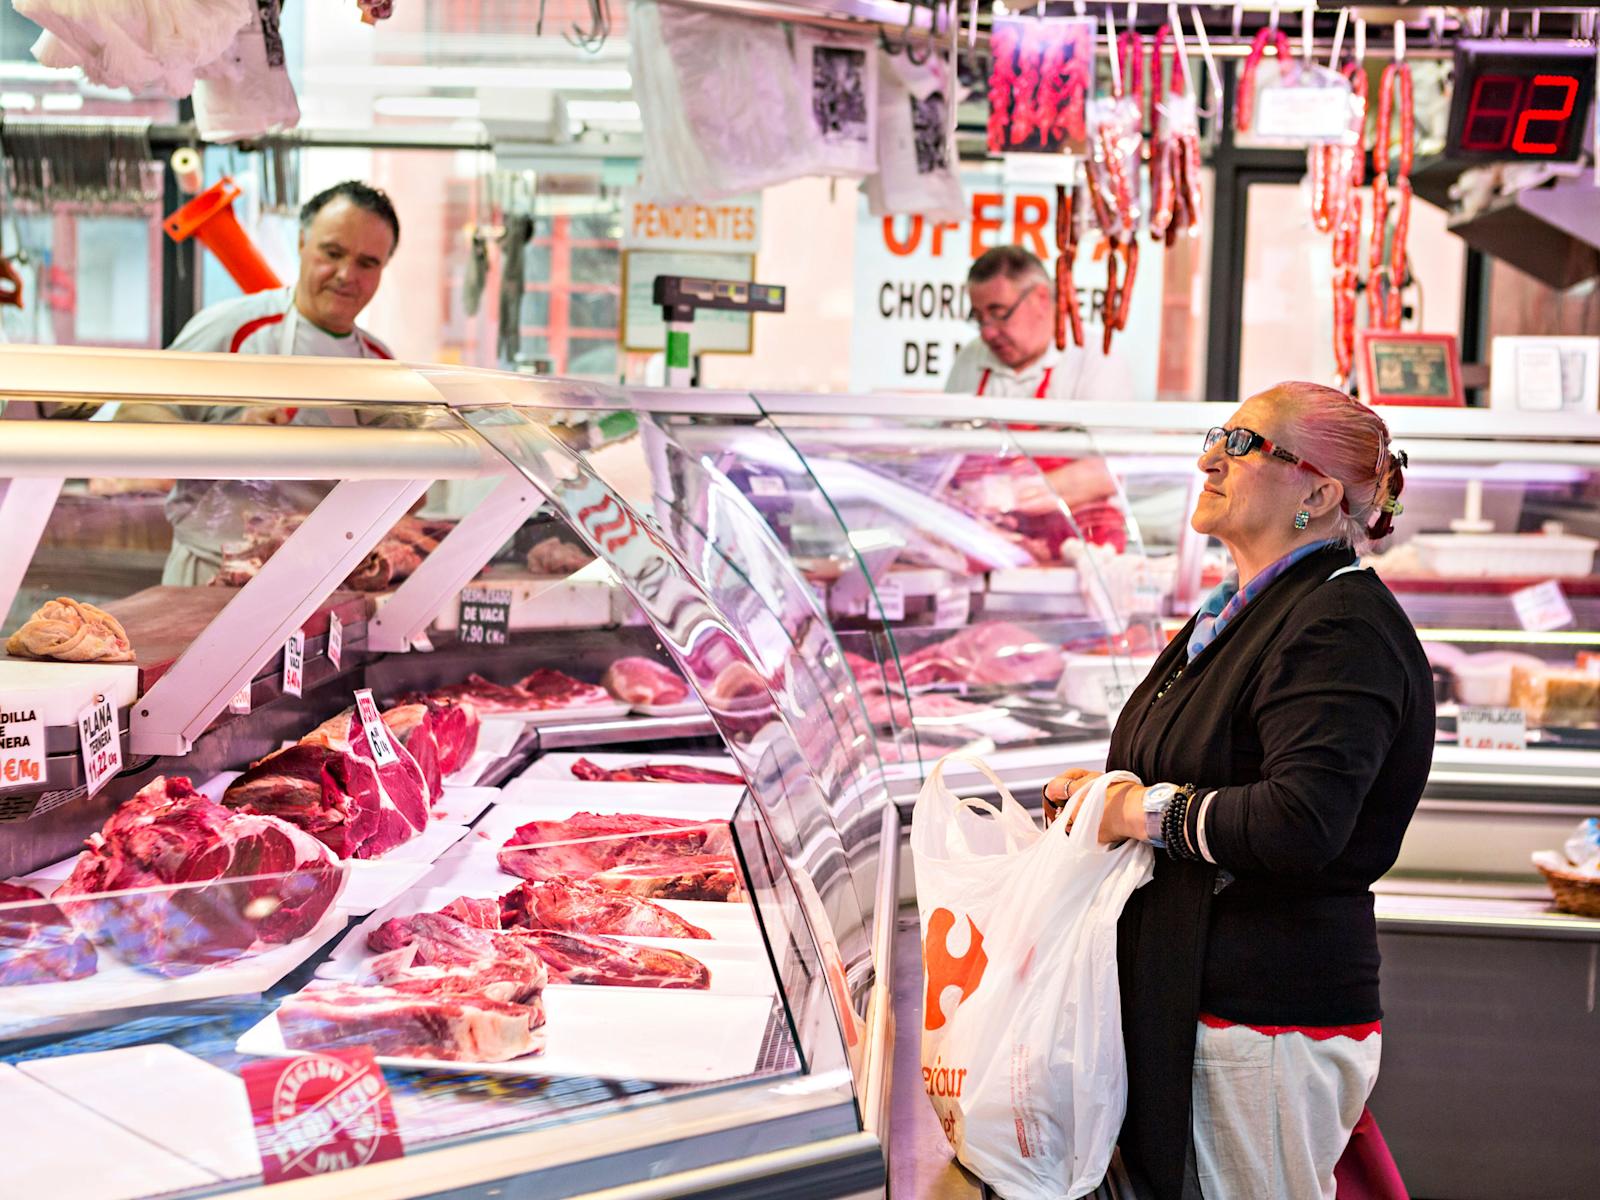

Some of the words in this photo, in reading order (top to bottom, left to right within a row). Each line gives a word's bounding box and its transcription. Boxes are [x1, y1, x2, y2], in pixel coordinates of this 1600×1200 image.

[1512, 75, 1579, 154] 2
[632, 203, 754, 241] PENDIENTES
[881, 194, 1130, 262] OFER
[904, 342, 939, 375] DE
[463, 606, 477, 621] DE
[479, 608, 505, 623] VACA
[83, 702, 112, 742] PLANA
[88, 728, 112, 758] TERNERA
